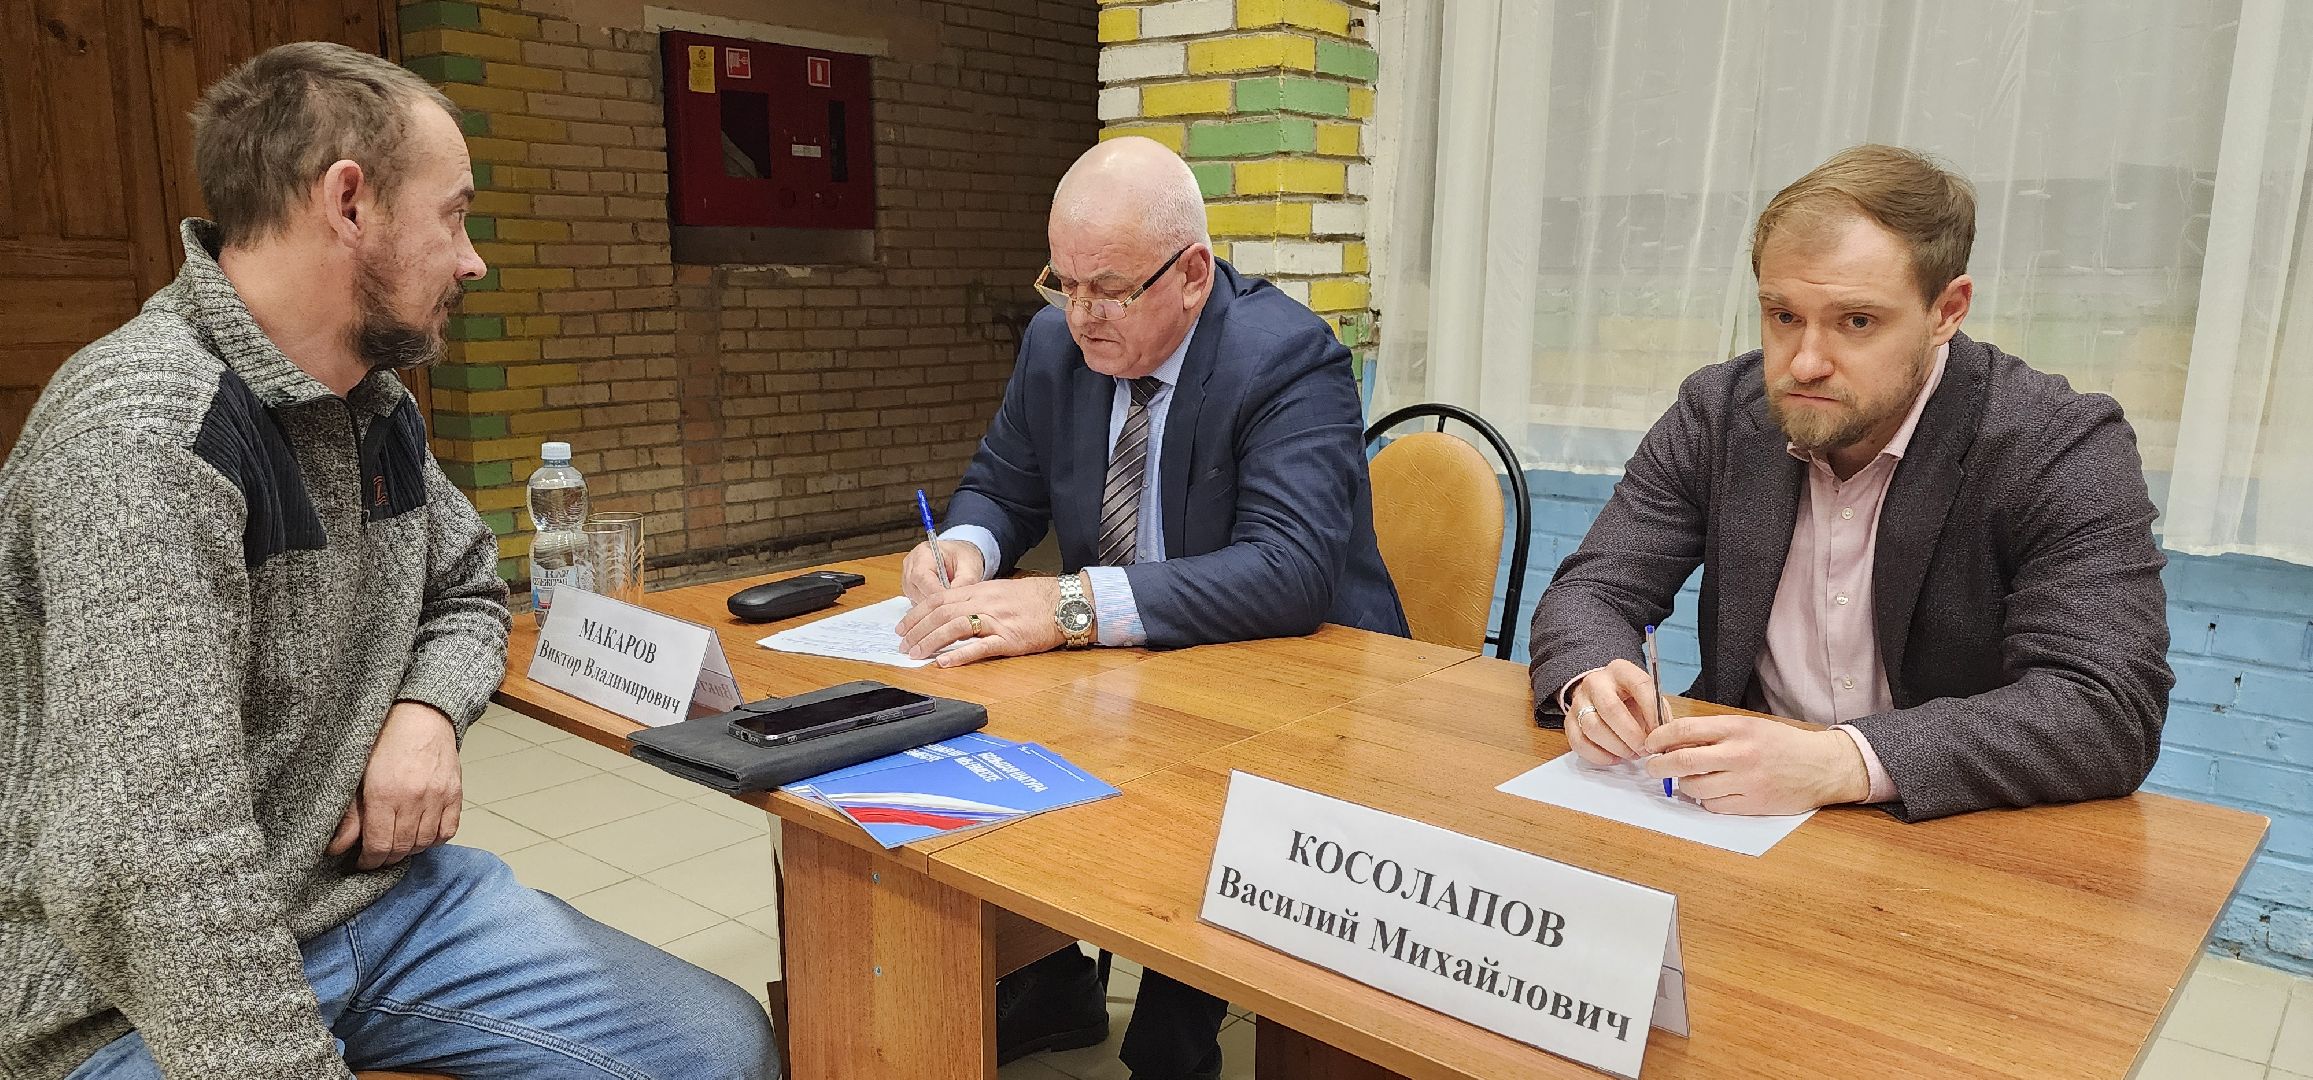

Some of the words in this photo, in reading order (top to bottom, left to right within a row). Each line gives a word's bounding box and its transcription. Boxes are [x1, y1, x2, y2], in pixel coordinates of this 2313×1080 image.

[538, 639, 582, 677] Виктор
[583, 657, 681, 714] Владимирович
[578, 618, 657, 664] МАКАРОВ
[1286, 829, 1566, 948] КОСОЛАПОВ
[1216, 865, 1361, 944] Василий
[1368, 917, 1632, 1042] Михайлович
